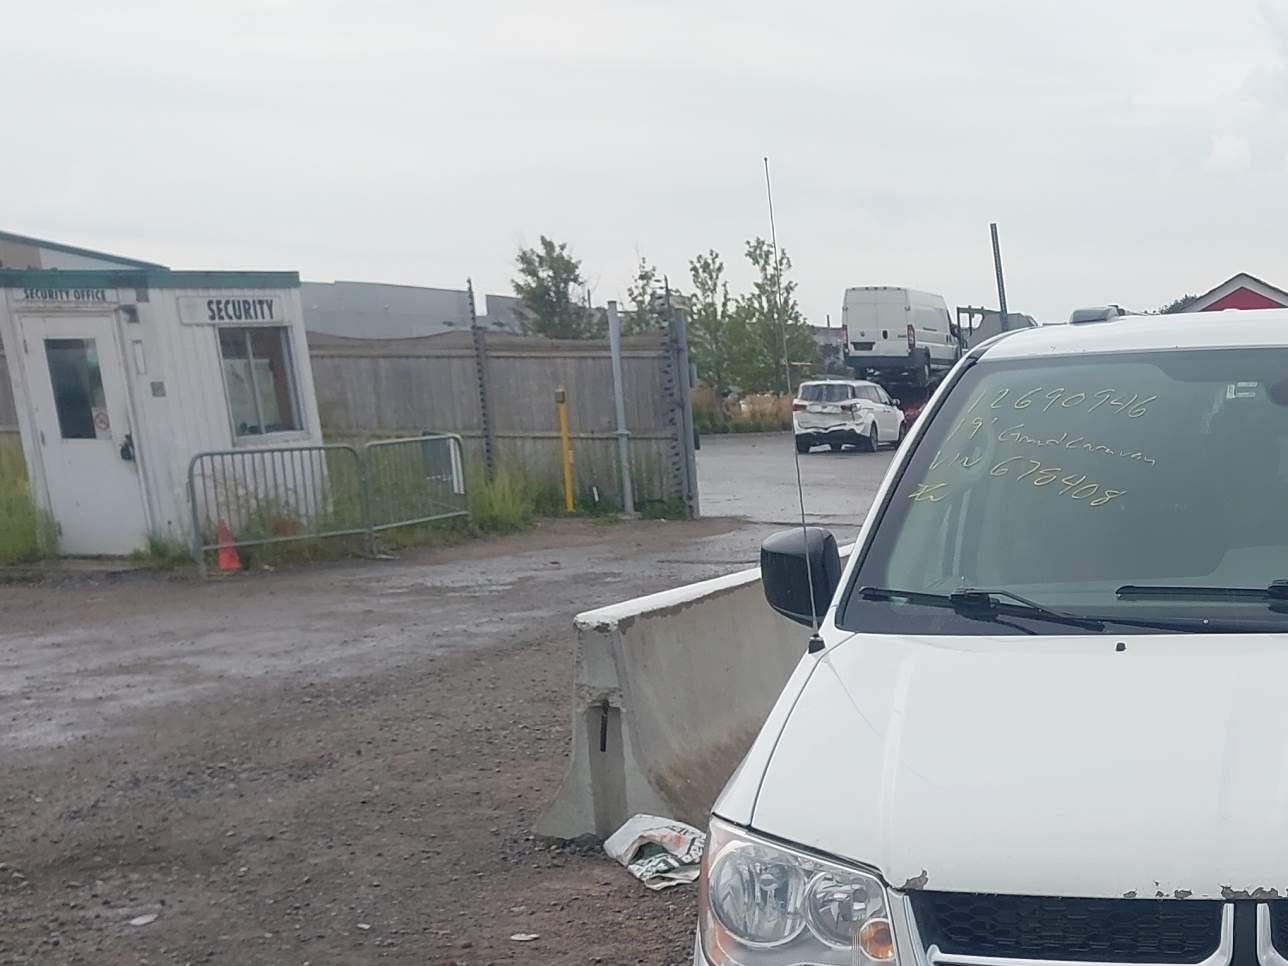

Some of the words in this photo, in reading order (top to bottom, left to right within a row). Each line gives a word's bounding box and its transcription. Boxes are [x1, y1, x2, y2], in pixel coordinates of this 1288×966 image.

[23, 288, 71, 302] SECURITY
[72, 289, 107, 302] OFFICE
[207, 299, 274, 321] SECURITY
[968, 387, 1158, 418] 12690946
[990, 455, 1127, 506] 678408
